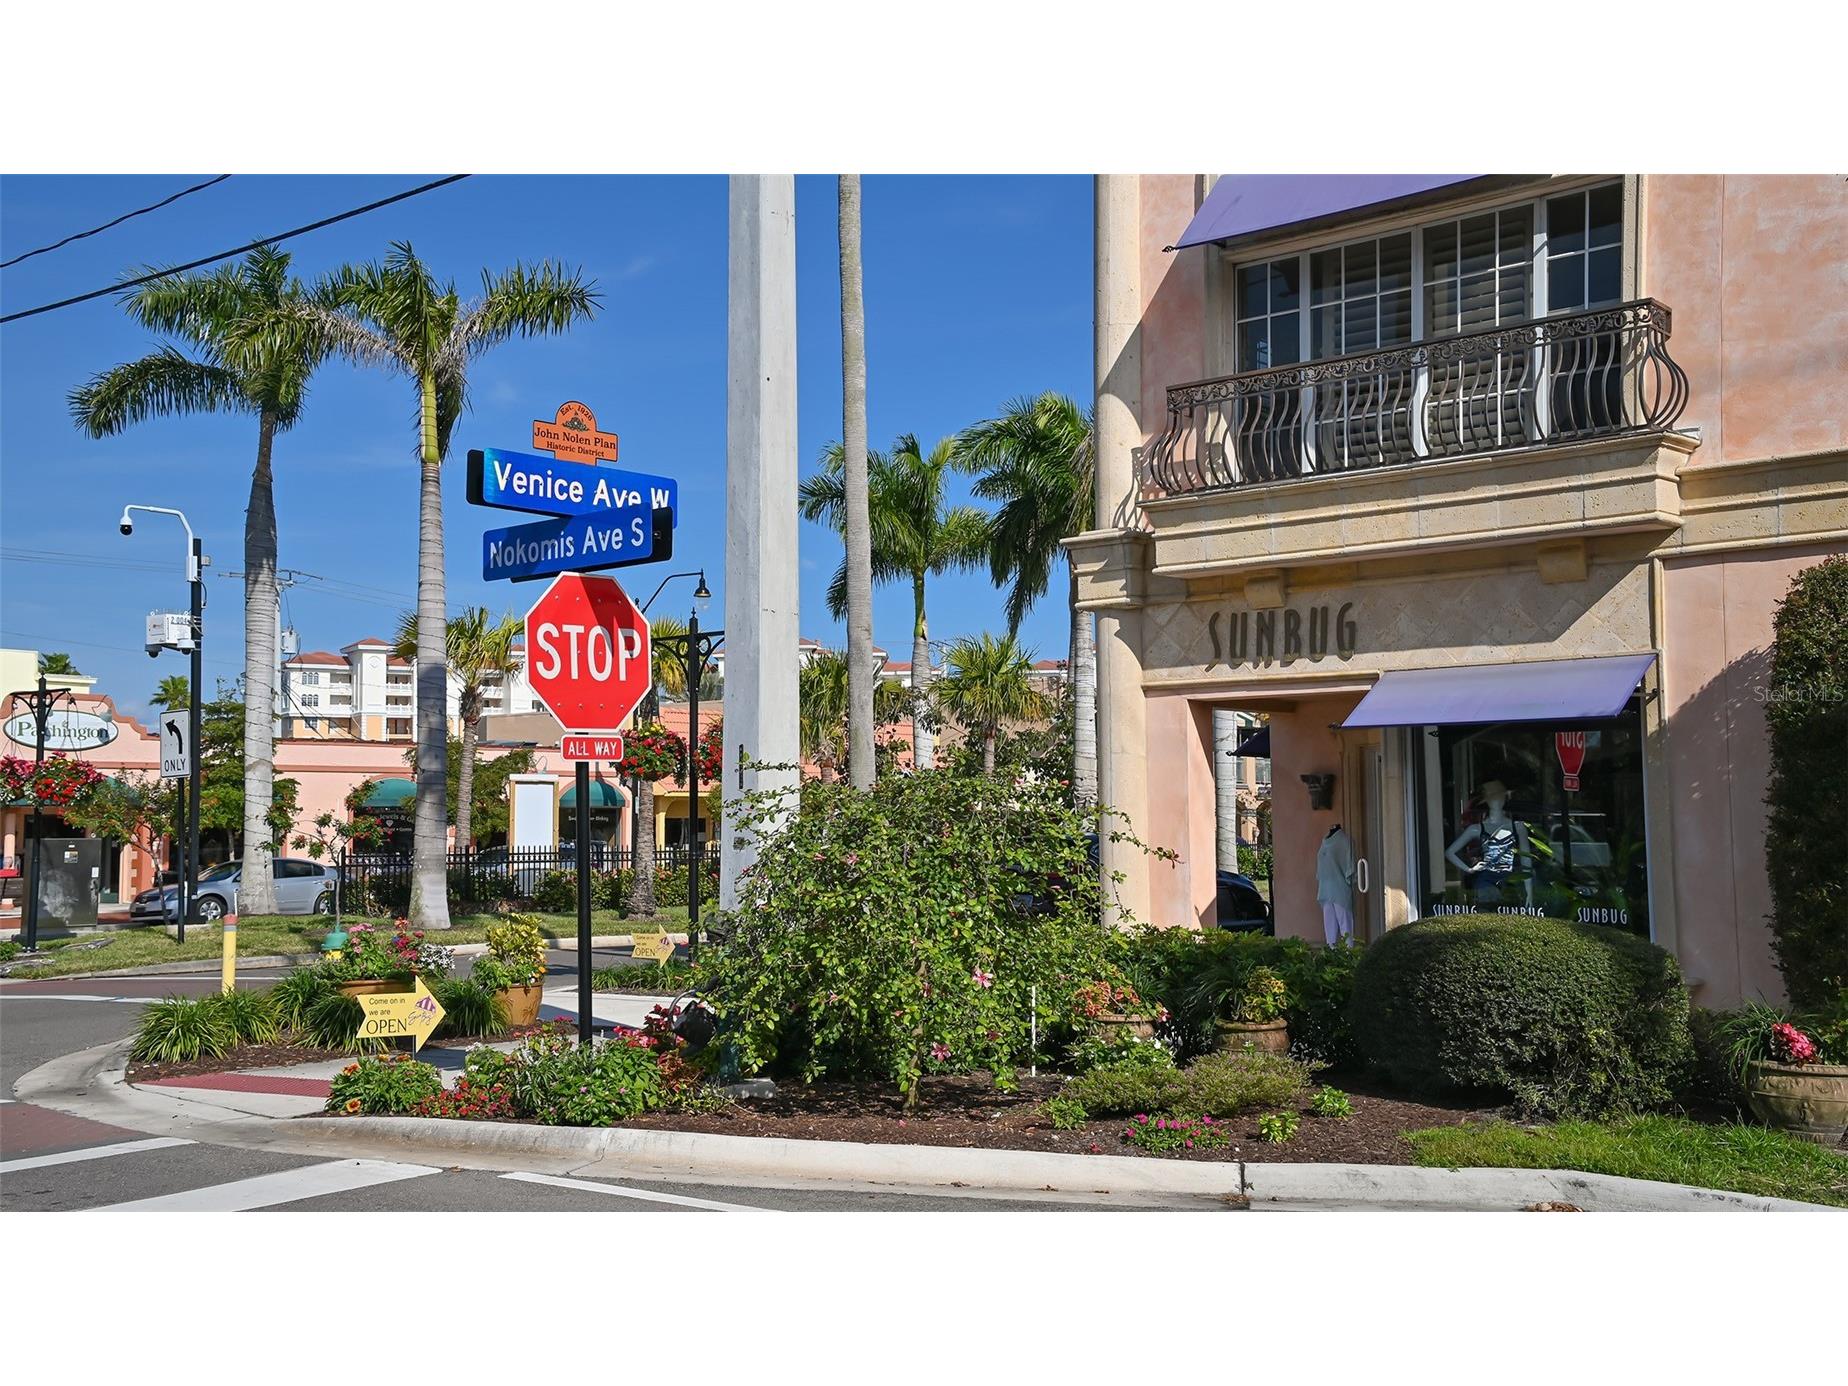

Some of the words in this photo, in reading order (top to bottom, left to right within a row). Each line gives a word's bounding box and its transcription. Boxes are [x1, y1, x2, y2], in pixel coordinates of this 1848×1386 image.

[560, 404, 575, 417] Est.
[534, 427, 560, 441] John
[562, 432, 591, 446] Nolen
[594, 436, 616, 450] Plan
[546, 440, 576, 453] Historic
[577, 446, 605, 458] District
[494, 460, 584, 503] Venice
[592, 478, 642, 508] Ave
[651, 487, 670, 510] W
[489, 530, 576, 569] Nokomis
[582, 525, 624, 555] Ave
[631, 517, 645, 547] S
[1204, 601, 1357, 673] SUNBUG
[535, 622, 642, 682] STOP
[568, 741, 590, 756] ALL
[594, 741, 618, 756] WAY
[164, 758, 187, 772] ONLY
[1577, 907, 1627, 925] SUNBUG
[369, 997, 388, 1006] Come
[366, 1018, 407, 1035] OPEN
